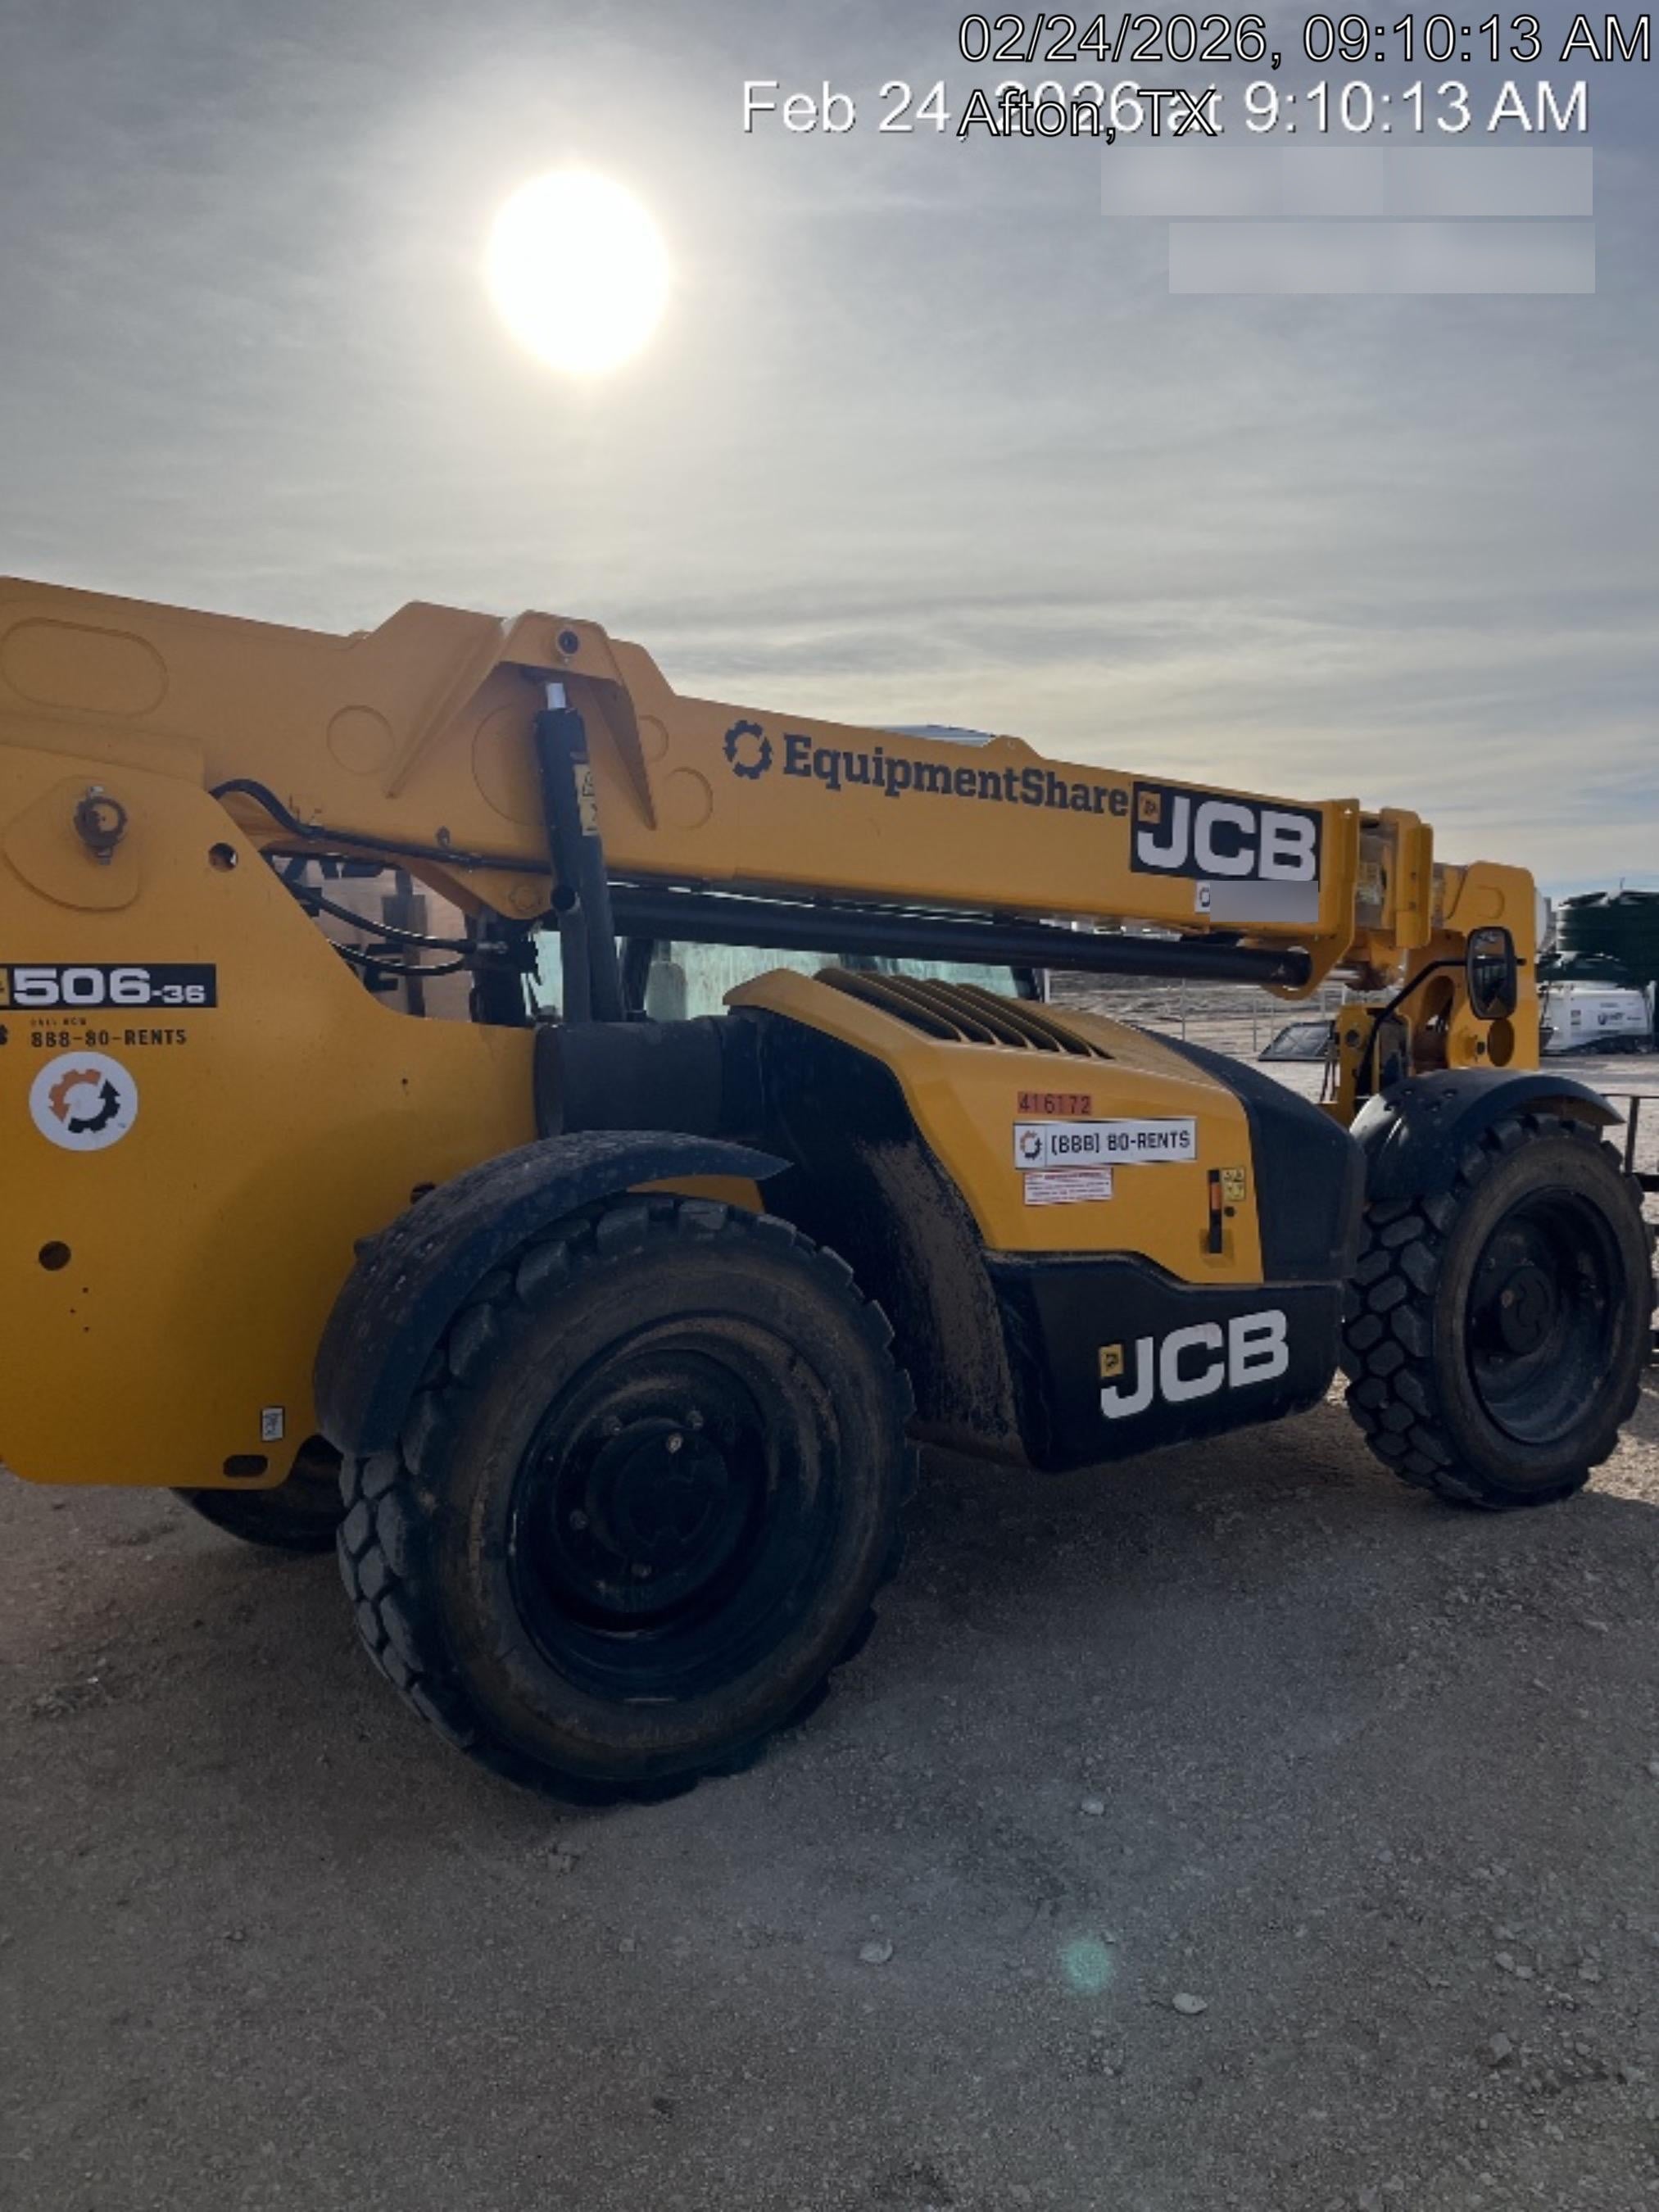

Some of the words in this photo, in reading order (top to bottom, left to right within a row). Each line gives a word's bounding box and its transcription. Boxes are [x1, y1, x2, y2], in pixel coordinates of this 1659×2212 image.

[782, 733, 1129, 818] EquipmentShare
[1136, 796, 1317, 882] JCB
[12, 968, 206, 1006] 506-36
[1019, 1094, 1091, 1114] 416172
[1100, 1309, 1290, 1419] JCB
